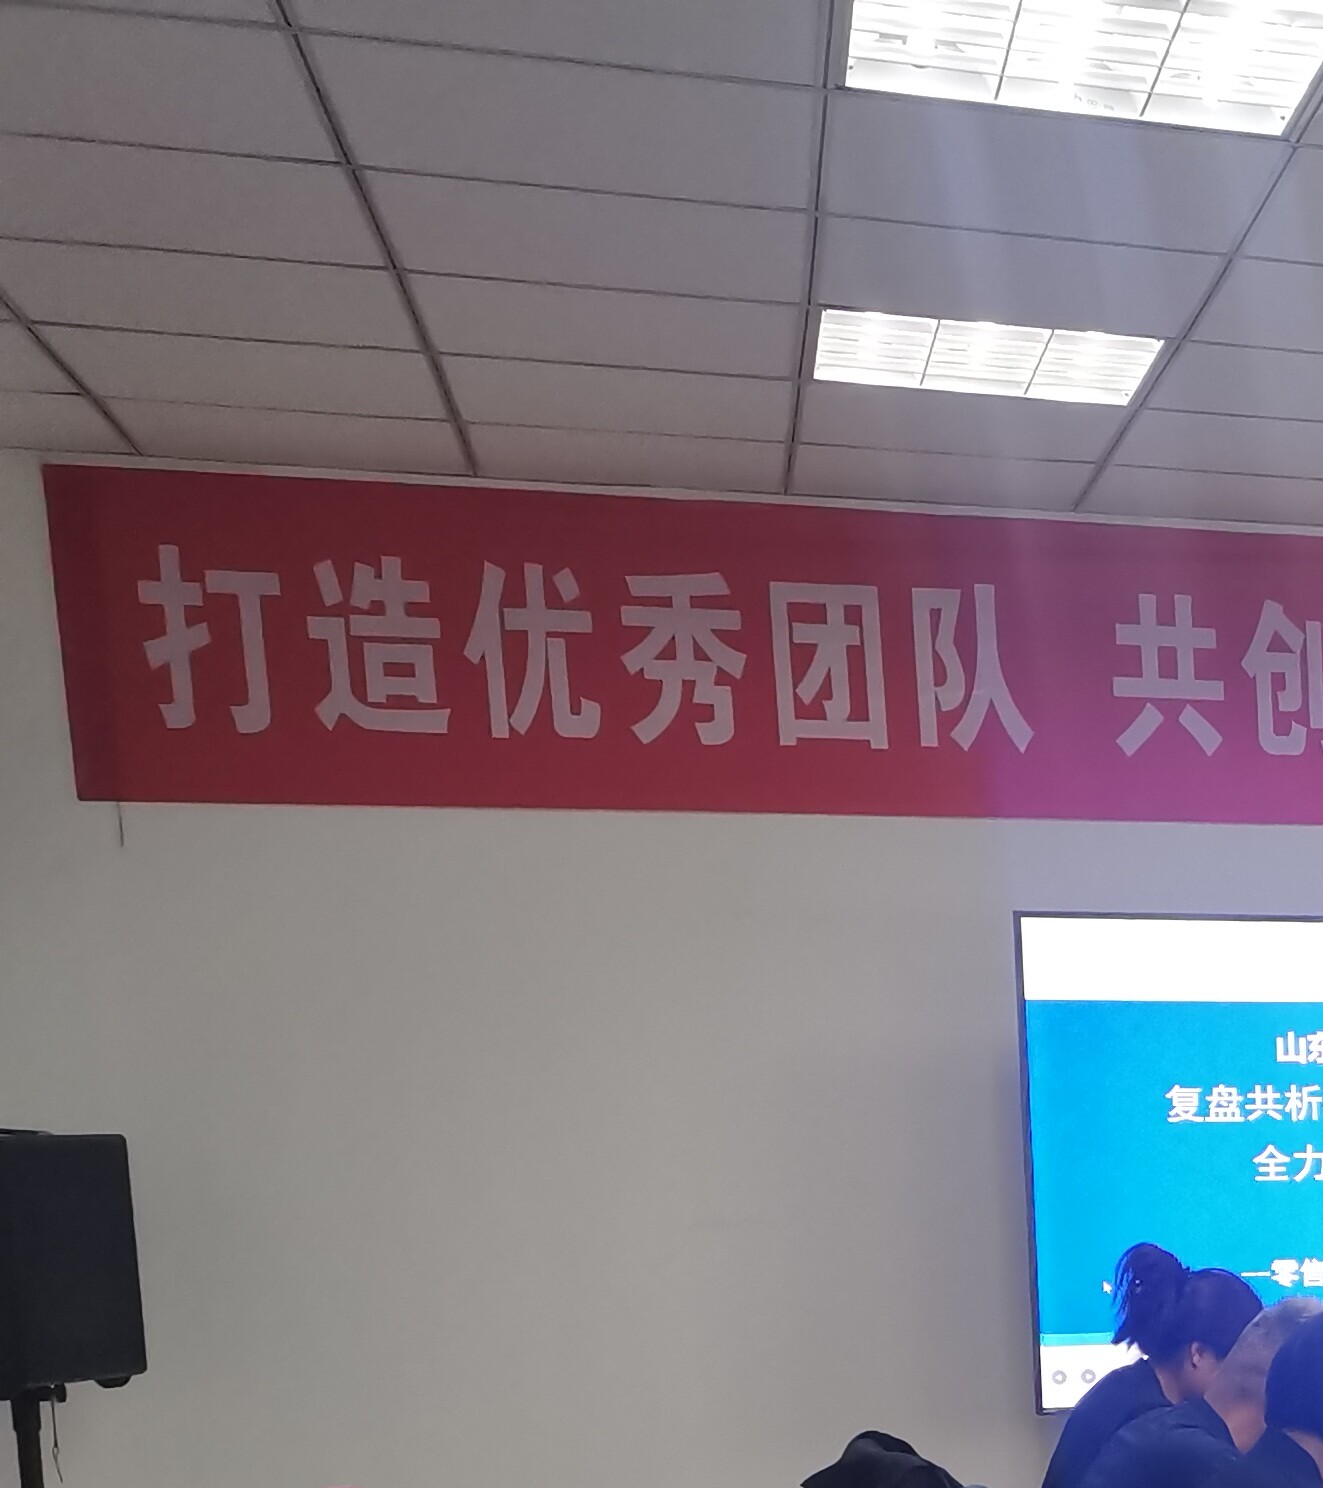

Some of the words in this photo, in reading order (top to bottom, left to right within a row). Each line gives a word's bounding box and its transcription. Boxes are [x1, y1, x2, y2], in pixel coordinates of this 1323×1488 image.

[137, 544, 1034, 754] 打造优秀团队
